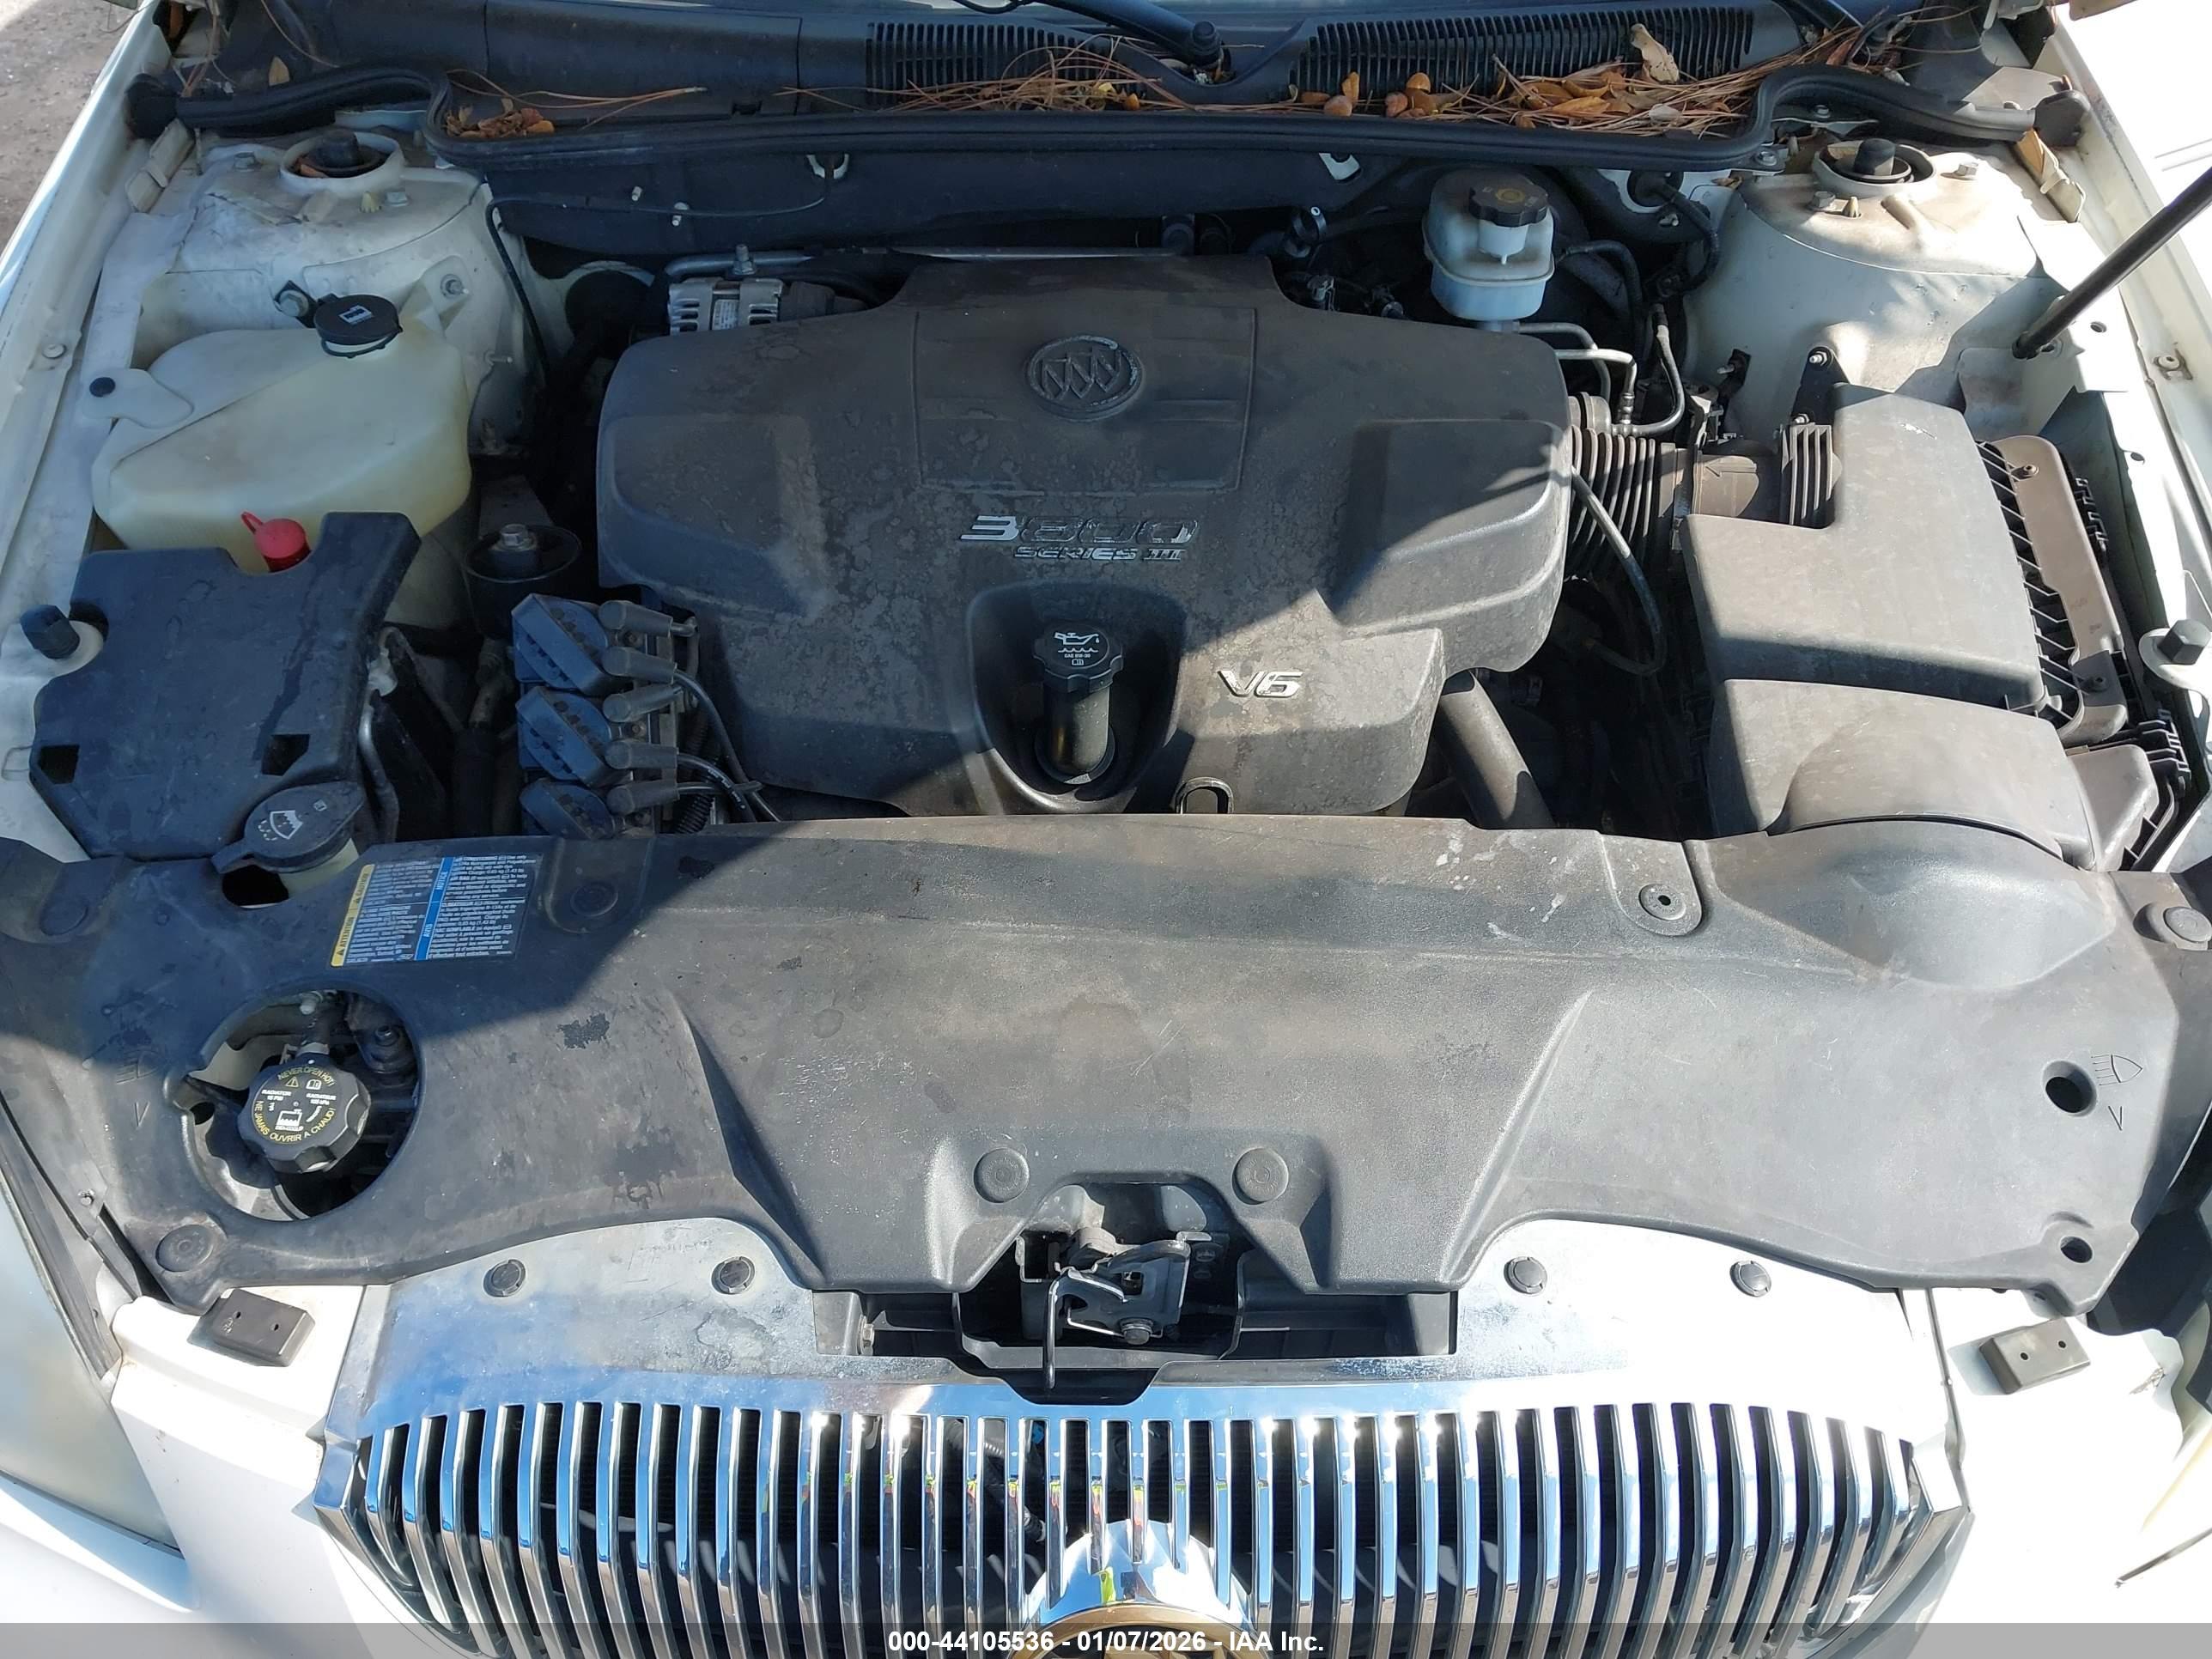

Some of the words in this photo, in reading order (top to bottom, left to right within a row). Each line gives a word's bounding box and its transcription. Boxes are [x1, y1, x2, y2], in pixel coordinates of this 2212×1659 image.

[959, 515, 1200, 544] 3800
[1014, 546, 1138, 561] SERIES
[1217, 670, 1304, 698] V6
[436, 871, 448, 890] NOTICE
[277, 1066, 304, 1080] NEVER
[254, 1112, 270, 1135] JAMAIS
[269, 1132, 302, 1143] OUVRIR
